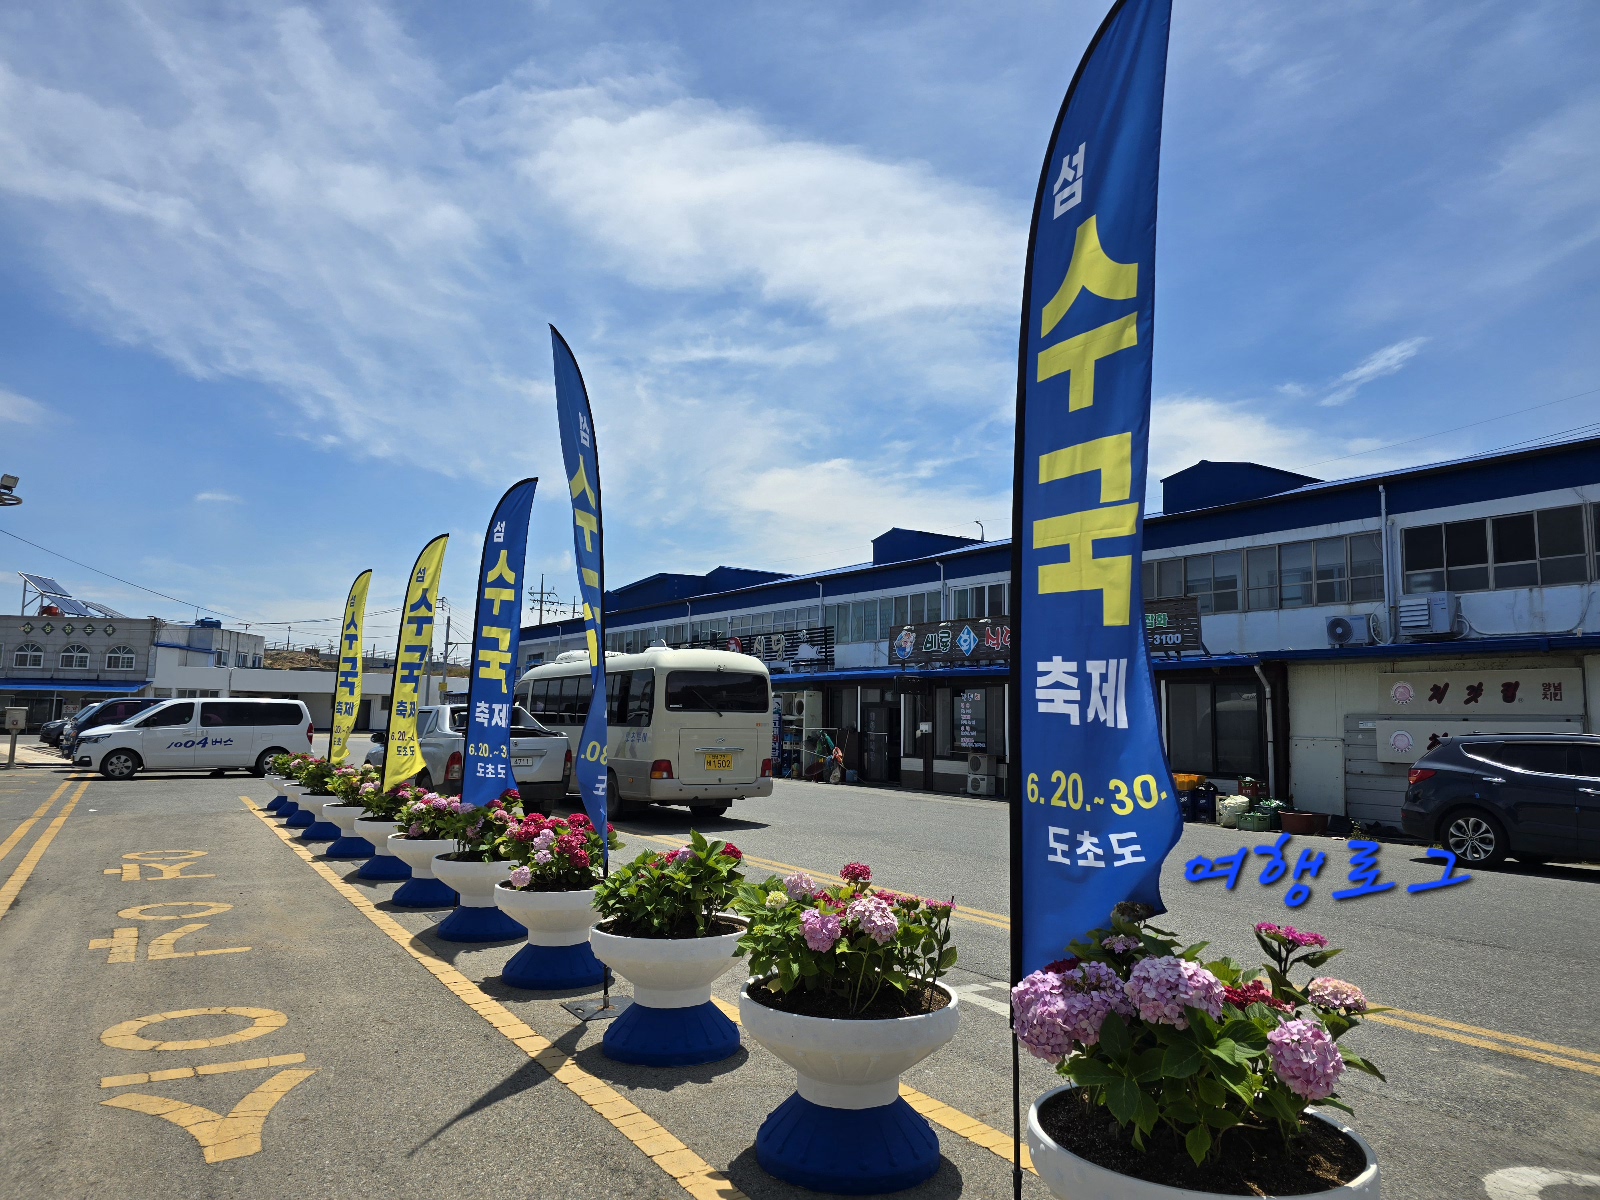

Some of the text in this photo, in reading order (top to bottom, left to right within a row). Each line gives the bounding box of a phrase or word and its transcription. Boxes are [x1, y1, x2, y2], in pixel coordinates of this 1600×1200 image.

[1033, 142, 1139, 627] 섬 수국
[477, 521, 515, 694] 섬 수국
[399, 567, 433, 694] 섬 수국
[340, 617, 359, 696] 수국
[1035, 656, 1128, 729] 축제
[1541, 682, 1562, 692] 양념
[1541, 692, 1562, 702] 치킨
[475, 701, 509, 729] 축제
[396, 745, 415, 757] 도초도
[477, 762, 506, 779] 도초도
[1027, 770, 1168, 816] 6.20.~30.
[1047, 826, 1147, 868] 도초도
